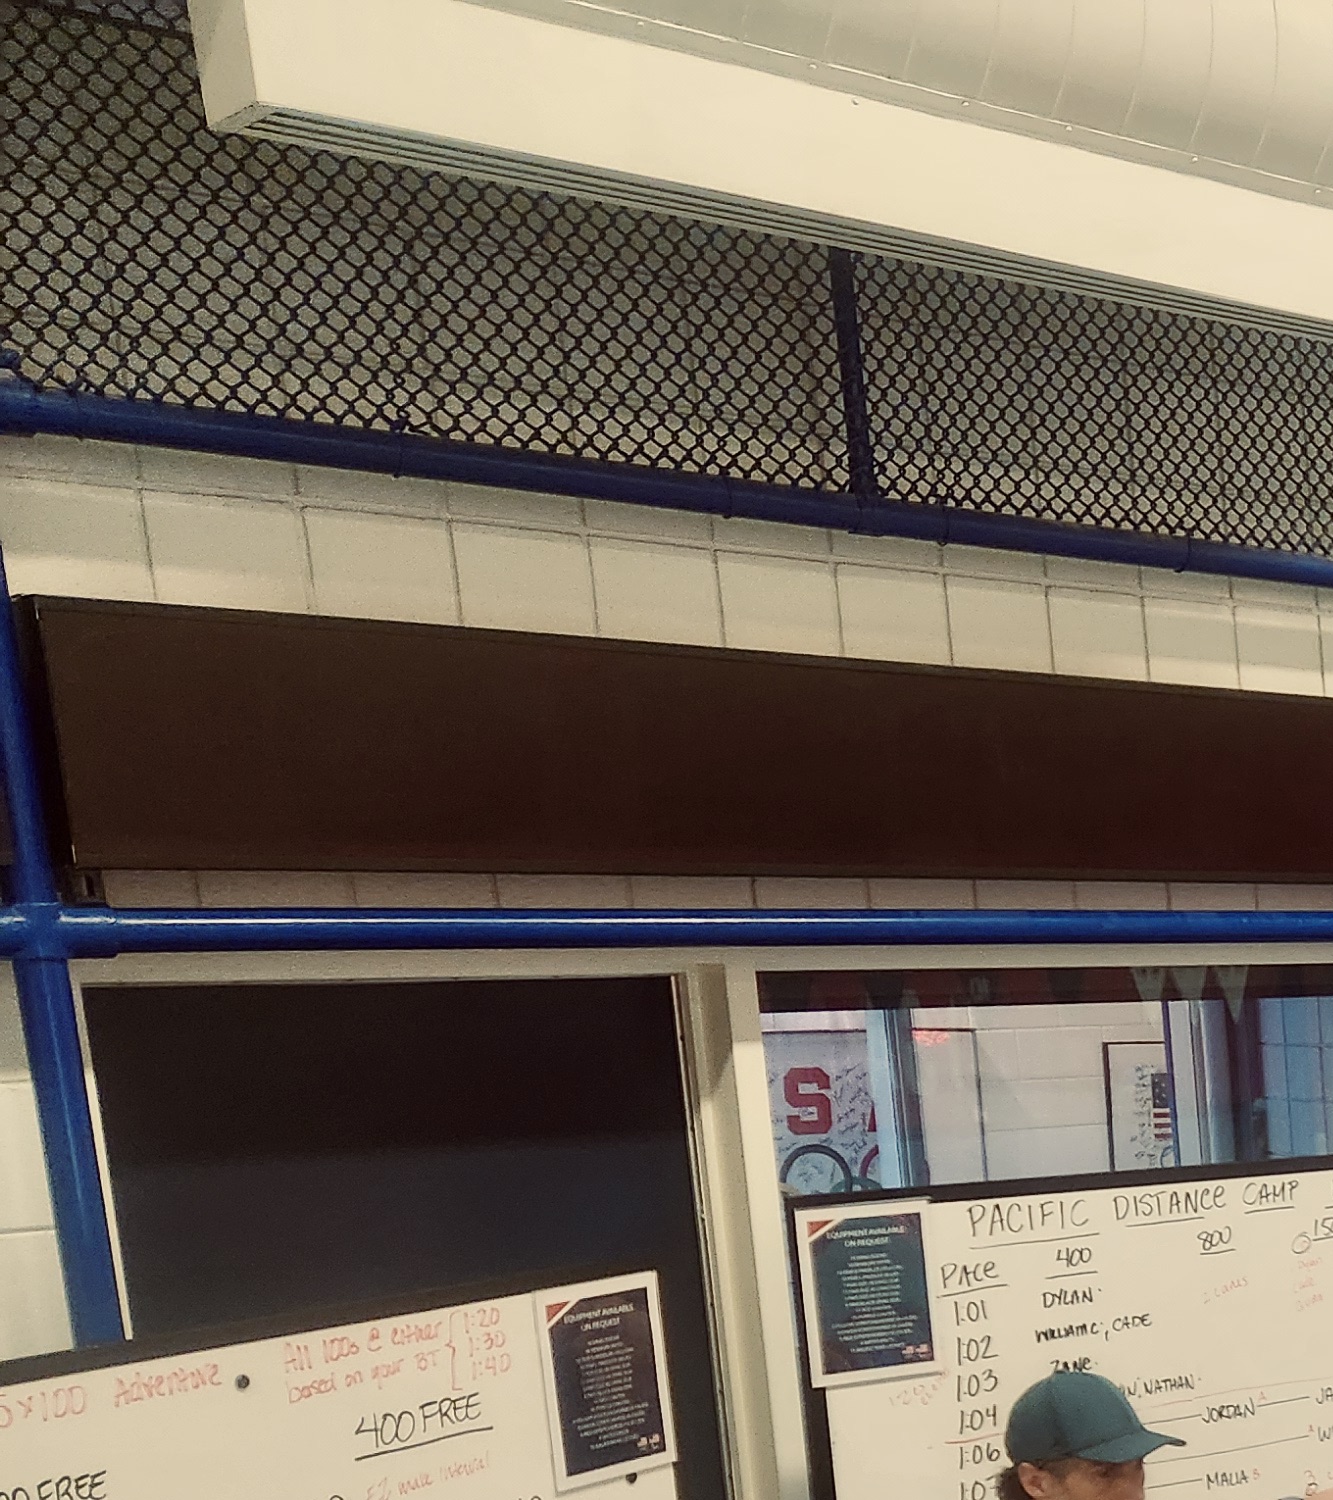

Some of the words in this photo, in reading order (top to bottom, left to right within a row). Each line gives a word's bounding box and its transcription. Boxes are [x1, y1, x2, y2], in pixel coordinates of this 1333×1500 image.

[968, 1199, 1089, 1237] PACIFIC
[1242, 1180, 1299, 1206] CAMP
[1198, 1225, 1232, 1250] 800
[1056, 1246, 1091, 1267] 400
[954, 1299, 988, 1326] 1:01
[1042, 1287, 1093, 1309] DYLAN
[463, 1307, 500, 1334] 1:20
[469, 1330, 506, 1357] 1:30
[957, 1335, 999, 1365] 1:02
[1112, 1313, 1151, 1333] CADE
[957, 1369, 998, 1402] 1:03
[1143, 1374, 1195, 1394] NATHAN
[355, 1410, 416, 1448] 400
[419, 1392, 481, 1433] FREE
[959, 1404, 997, 1435] 1:04
[1201, 1397, 1256, 1423] JORDAN
[960, 1443, 1000, 1469] 1:06
